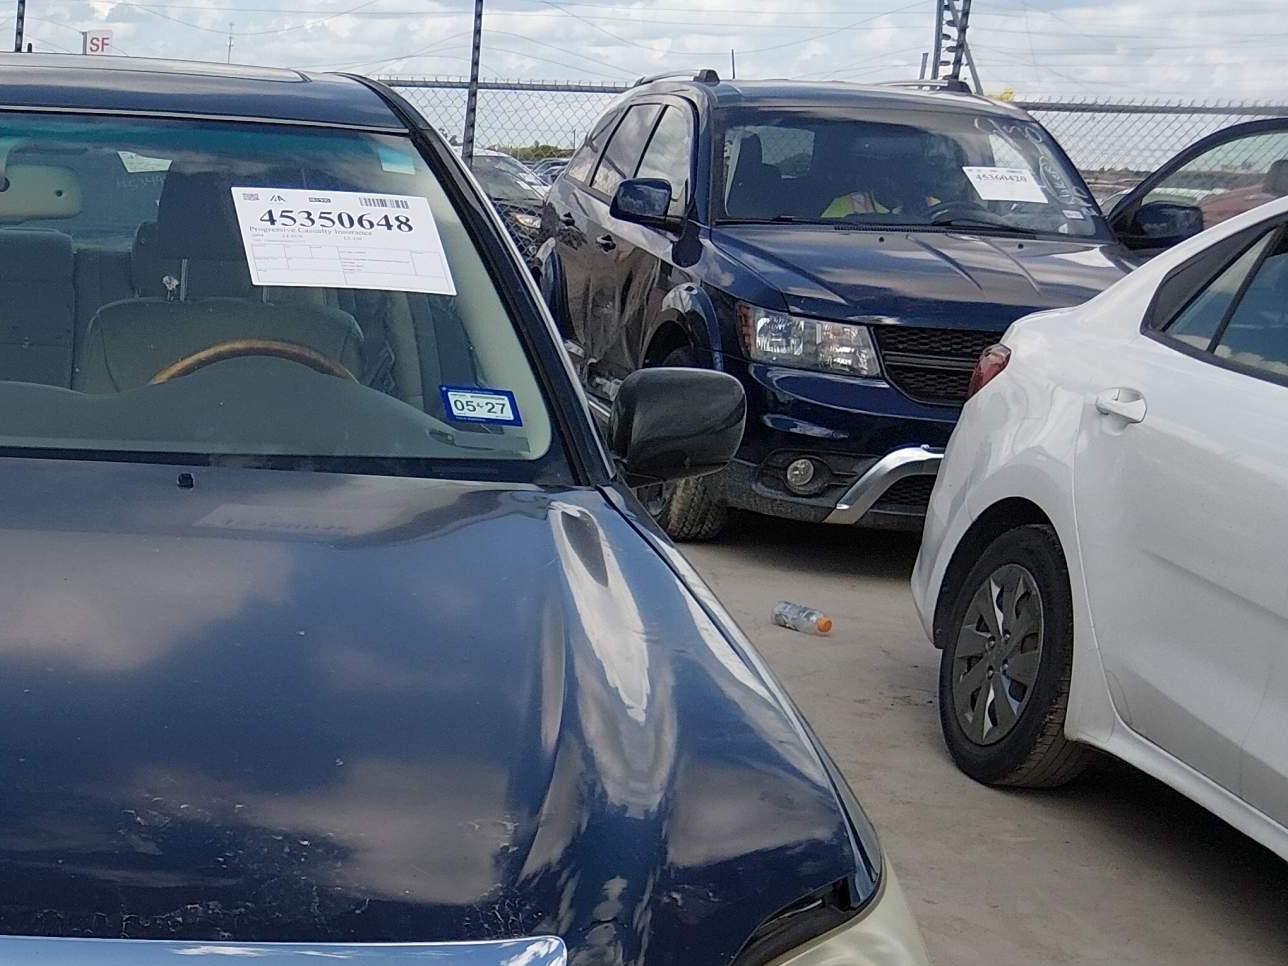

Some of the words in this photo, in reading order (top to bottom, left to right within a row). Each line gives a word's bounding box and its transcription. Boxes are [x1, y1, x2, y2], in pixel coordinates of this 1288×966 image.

[89, 36, 111, 53] SF
[259, 208, 414, 233] 45350648
[249, 225, 295, 234] Progressive
